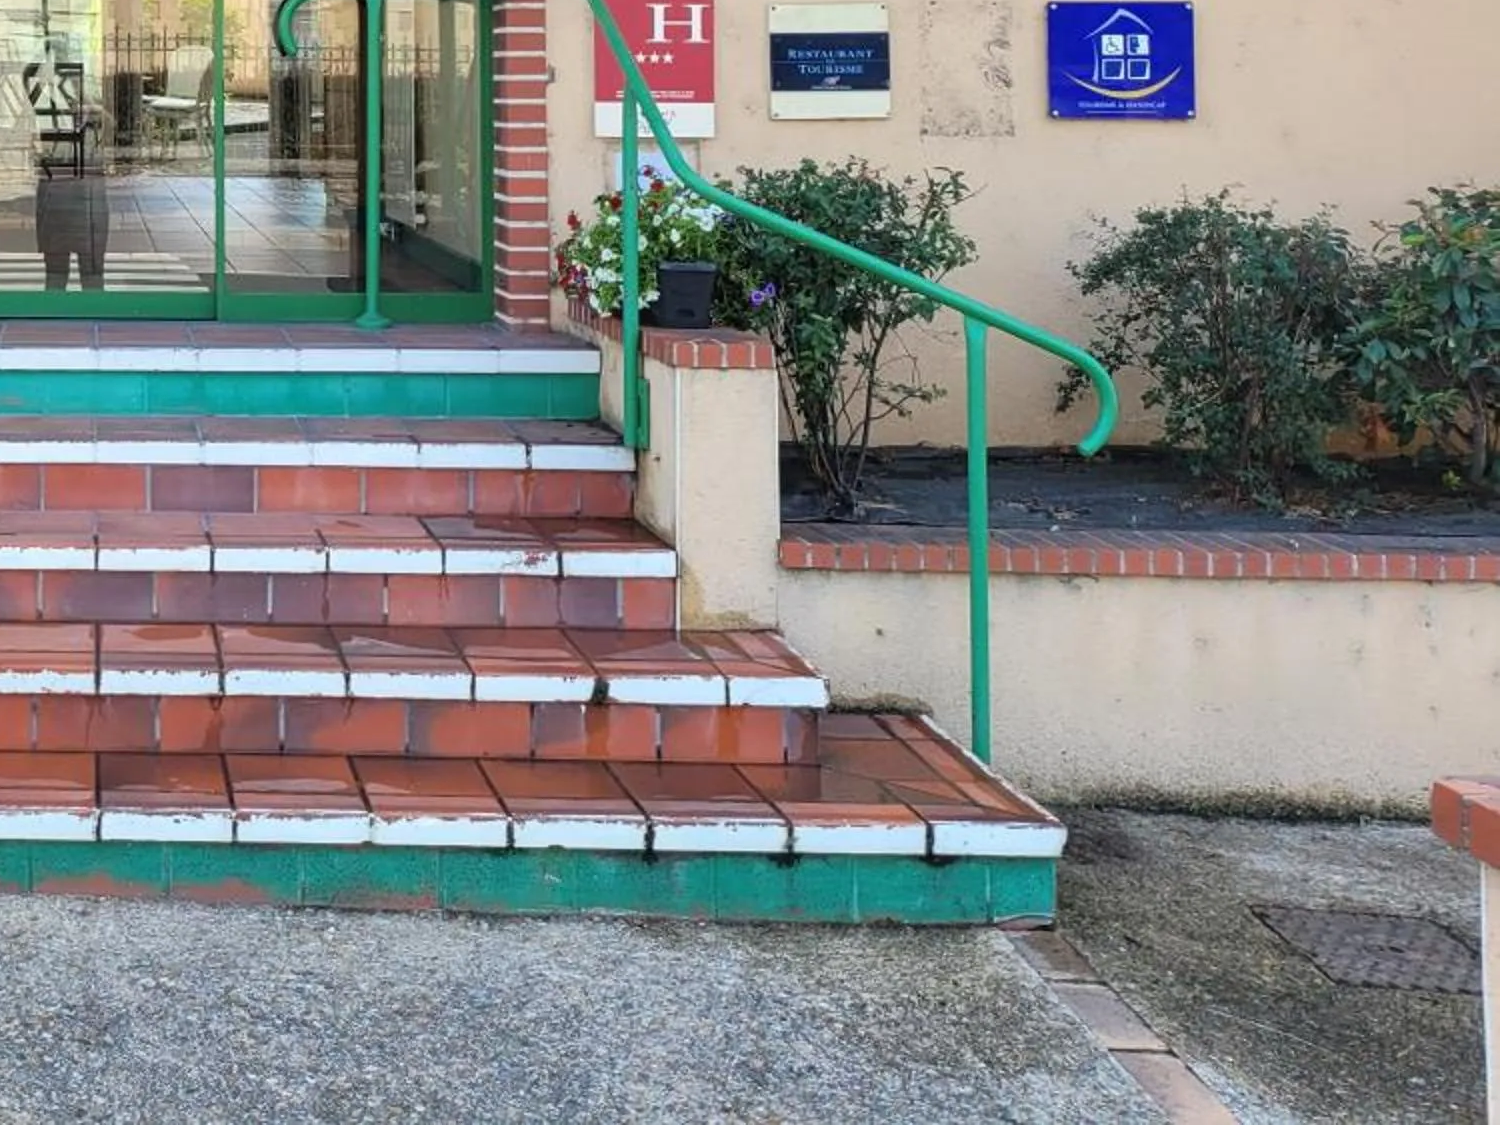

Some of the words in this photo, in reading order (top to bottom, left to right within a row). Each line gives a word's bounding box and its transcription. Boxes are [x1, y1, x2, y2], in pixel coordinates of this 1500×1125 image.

[645, 3, 710, 44] H
[787, 49, 874, 60] RESTAURANT
[798, 64, 863, 74] TOURISME
